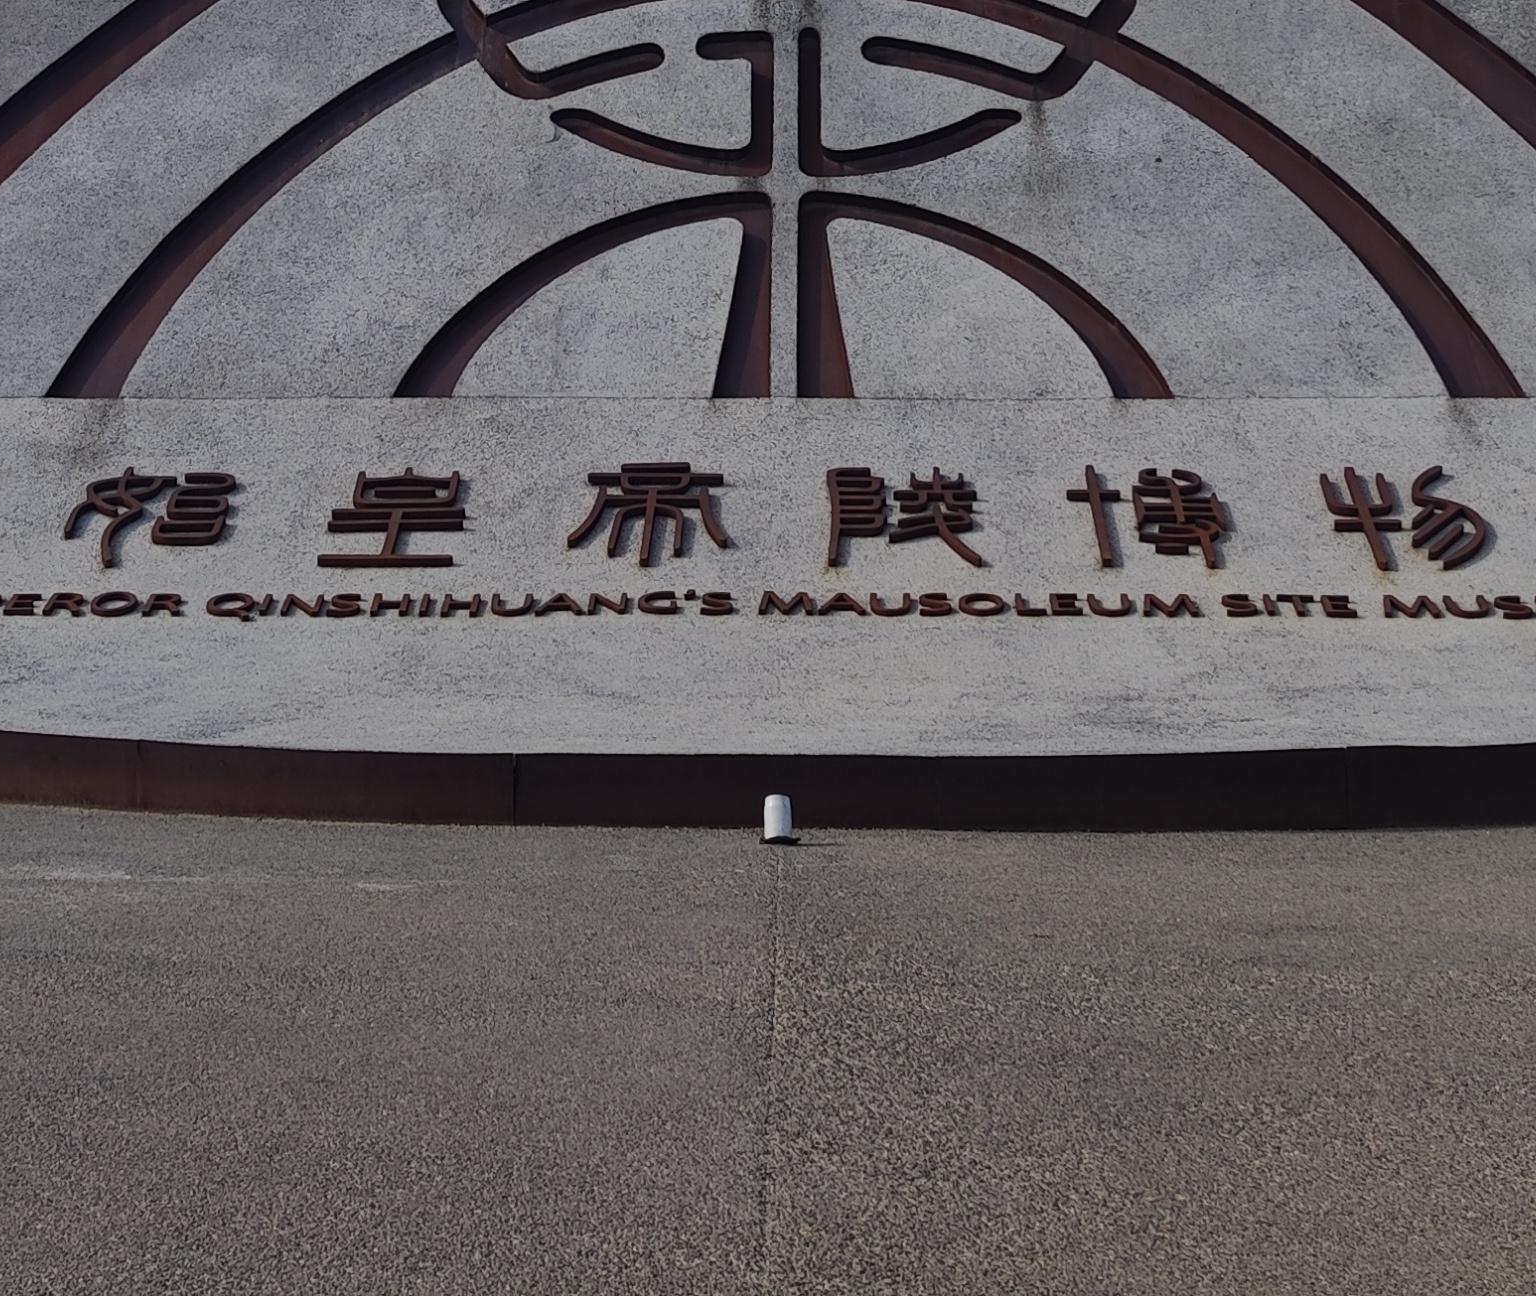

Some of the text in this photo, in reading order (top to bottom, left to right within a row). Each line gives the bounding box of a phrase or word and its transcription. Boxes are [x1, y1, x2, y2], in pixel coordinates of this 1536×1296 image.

[206, 589, 734, 622] QINSHIHUANG'S
[758, 590, 1201, 617] MAUSOLEUM
[1221, 593, 1358, 618] SITE
